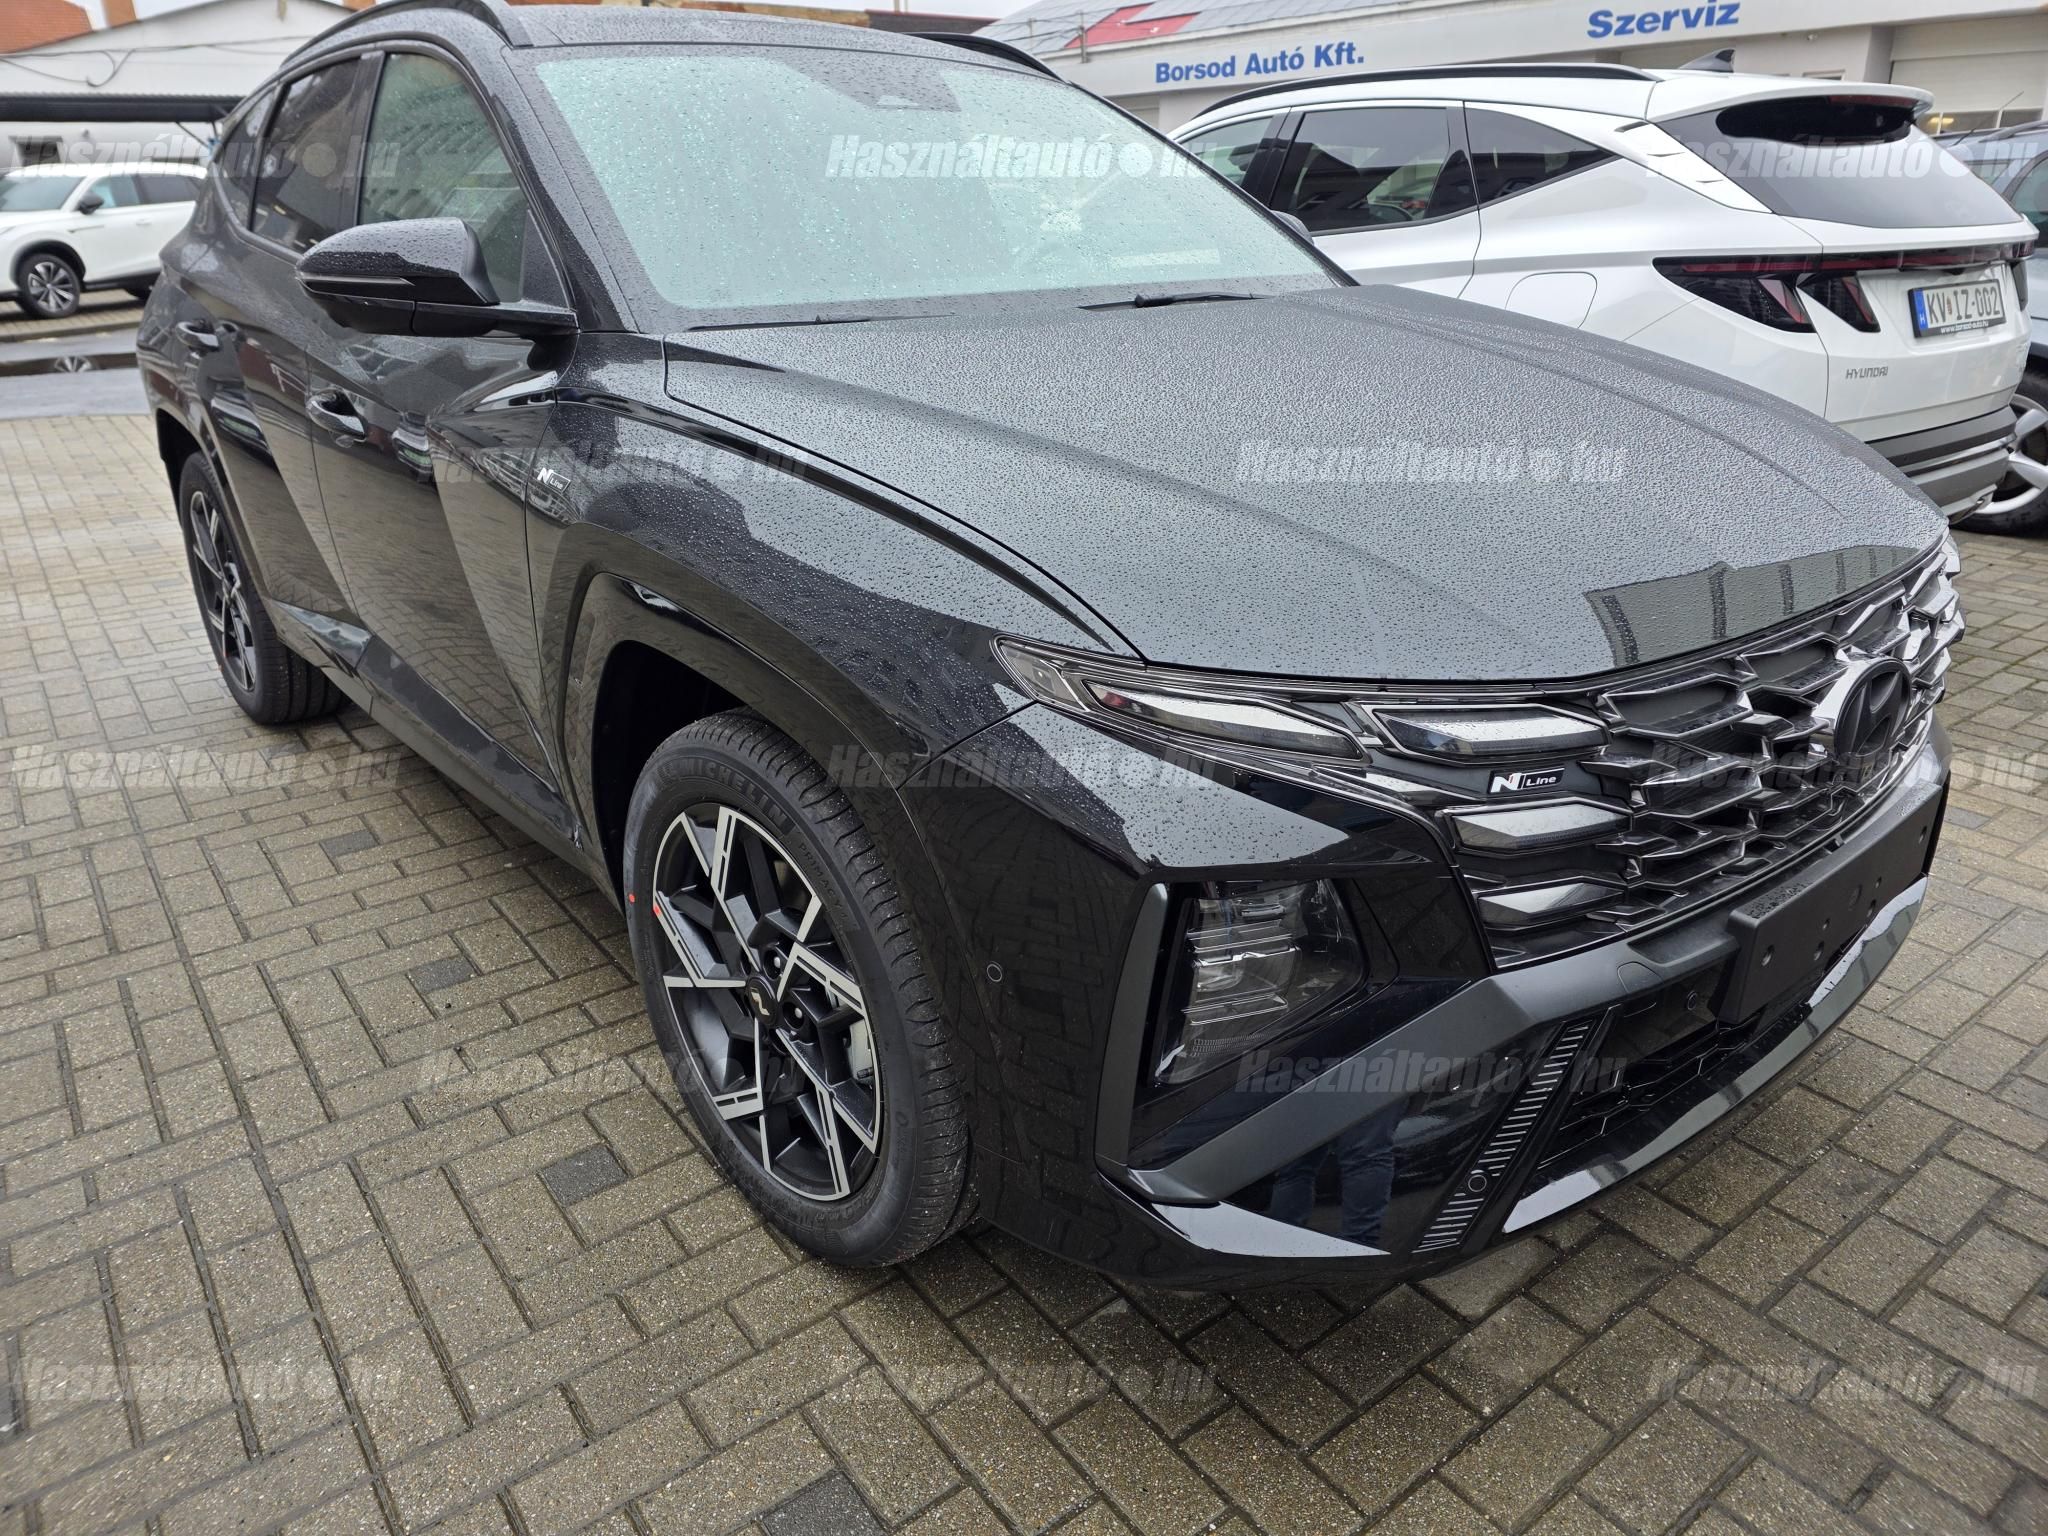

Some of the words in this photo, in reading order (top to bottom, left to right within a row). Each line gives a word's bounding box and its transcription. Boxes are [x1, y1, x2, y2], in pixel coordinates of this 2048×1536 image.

[1587, 0, 1740, 38] Szerviz
[1155, 55, 1236, 83] Borsod
[1244, 46, 1305, 75] Autó
[1314, 41, 1365, 68] Kft.
[1845, 366, 1889, 380] HYUNDAI
[537, 467, 554, 485] N
[679, 757, 788, 828] MICHELIN
[1491, 772, 1522, 793] N
